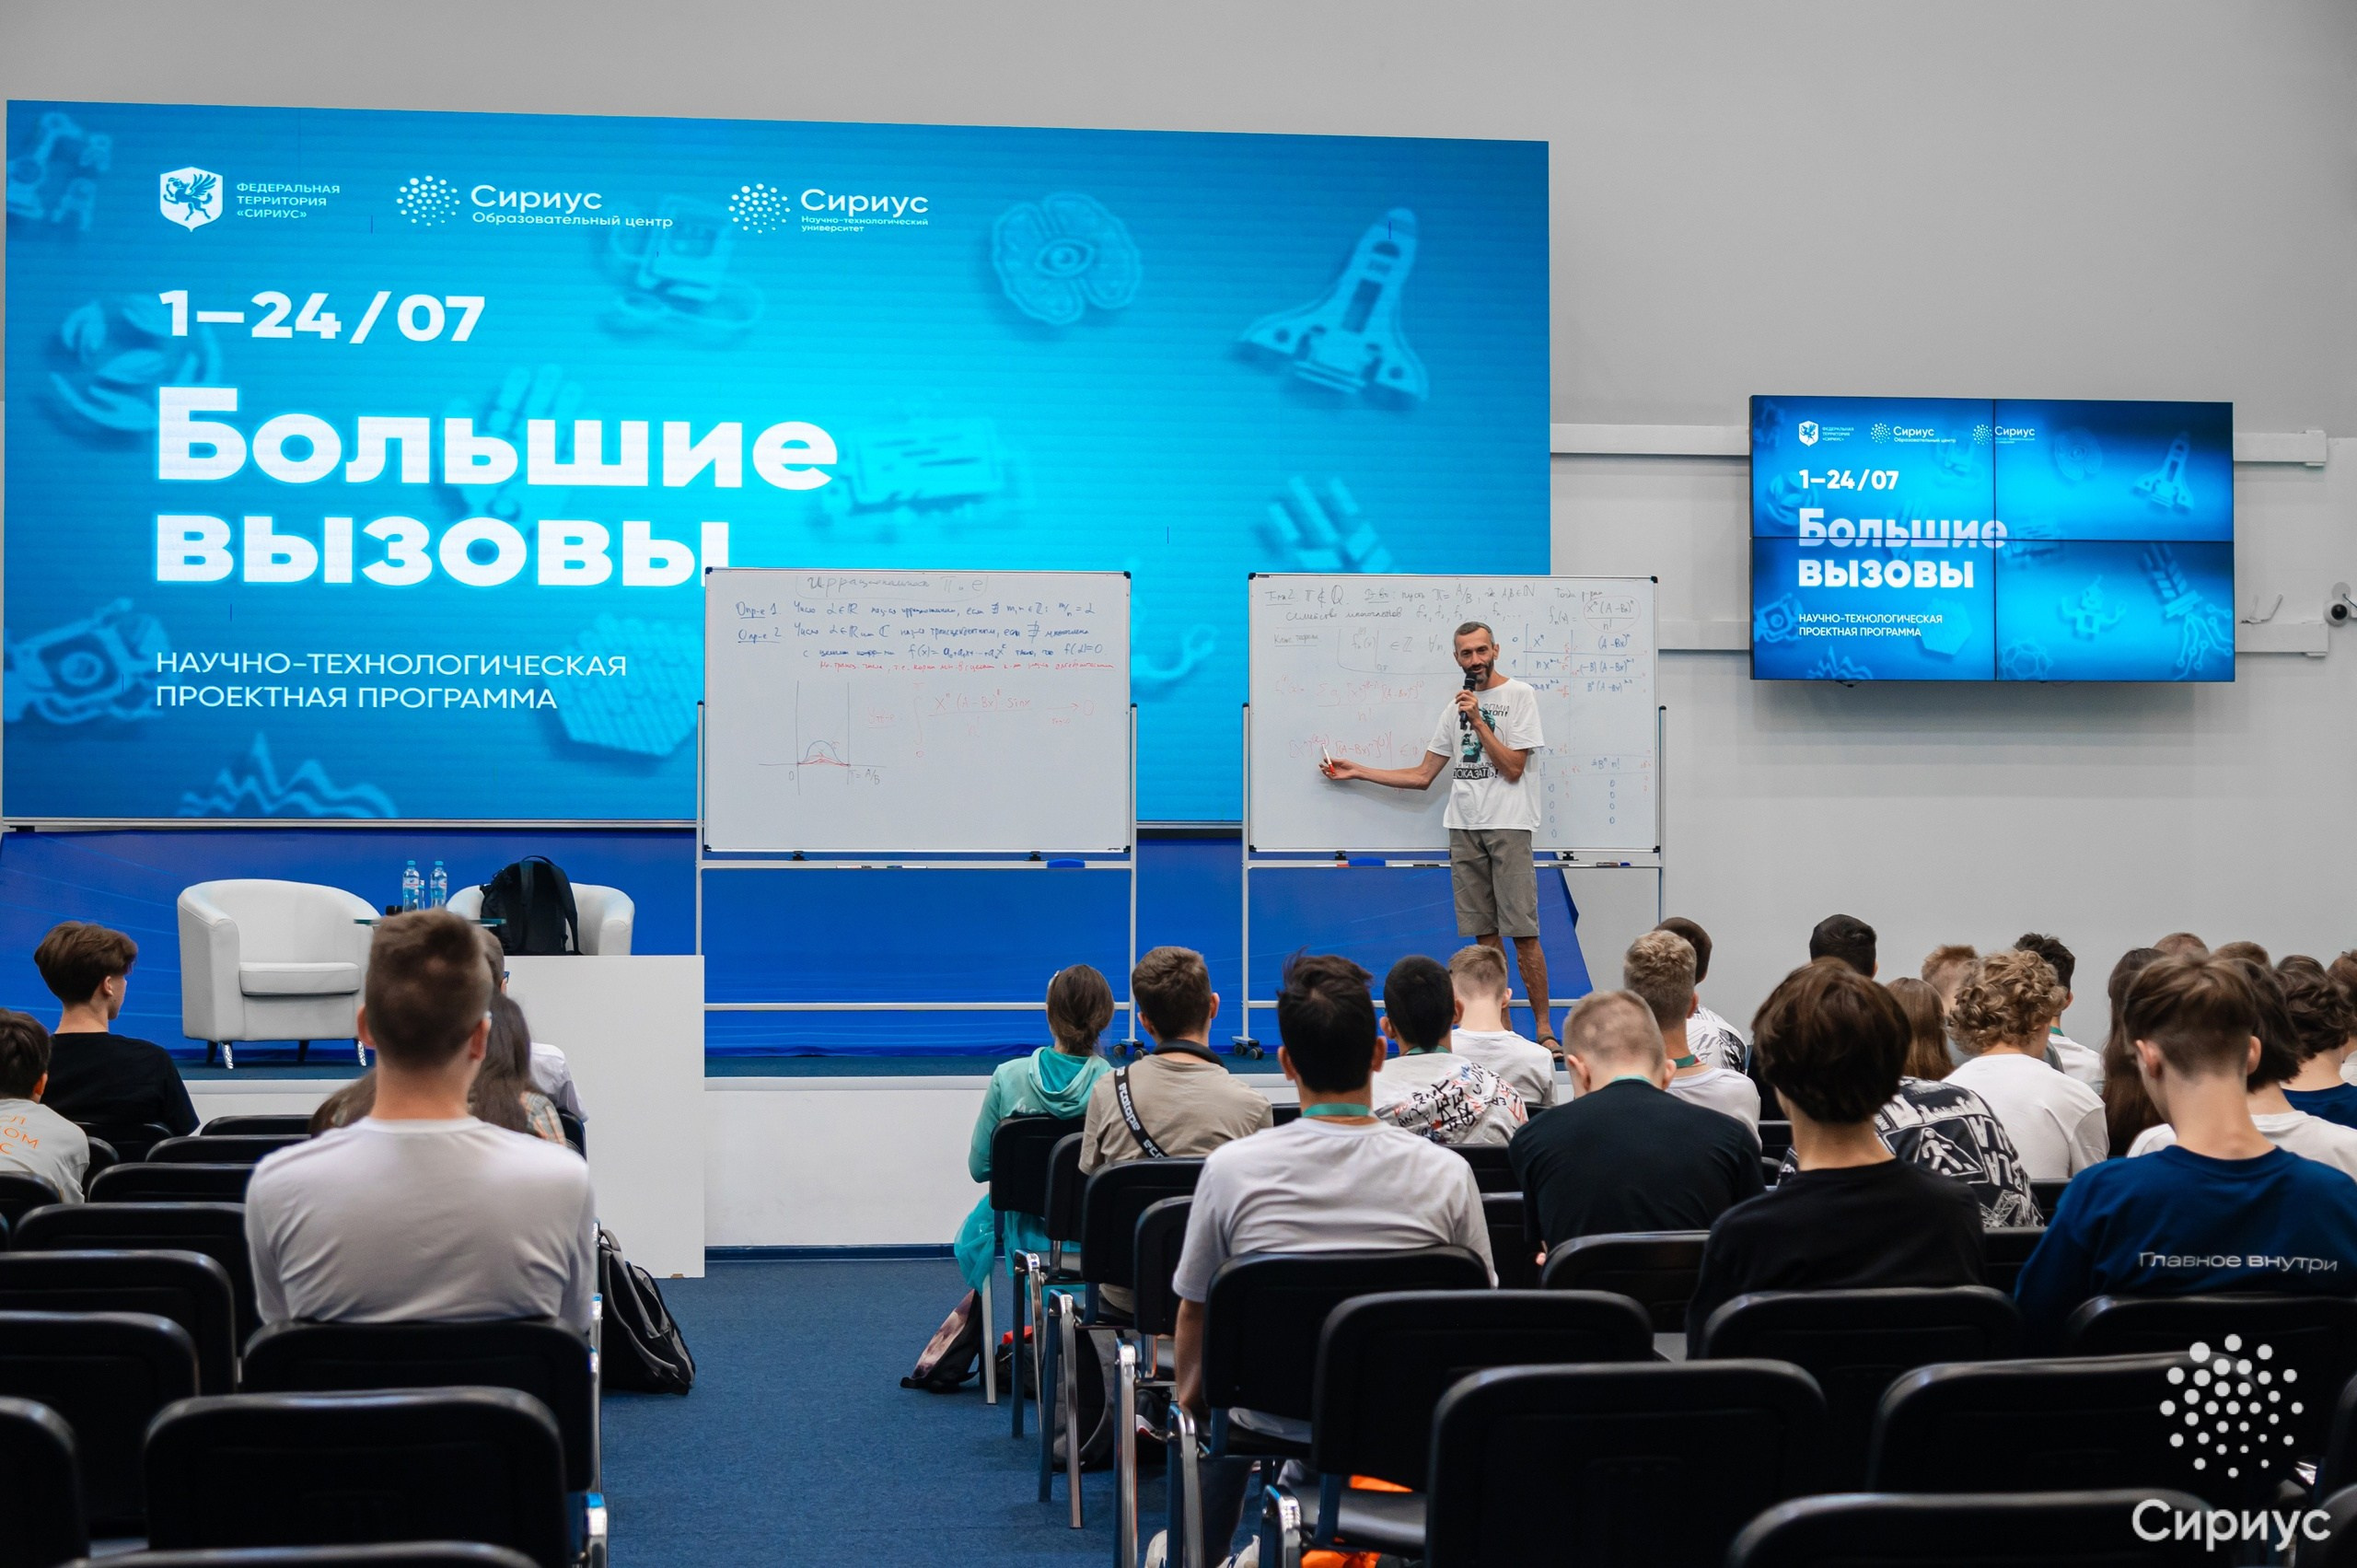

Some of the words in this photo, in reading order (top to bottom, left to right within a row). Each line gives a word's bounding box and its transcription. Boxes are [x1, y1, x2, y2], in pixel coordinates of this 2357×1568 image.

[237, 182, 341, 194] ФЕДЕРАЛЬНАЯ
[237, 195, 327, 206] ТЕРРИТОРИЯ
[470, 184, 603, 215] Сириус
[800, 188, 929, 218] Сириус
[237, 208, 308, 219] «СИРИУС»
[472, 212, 621, 226] Образовательный
[625, 216, 674, 229] центр
[801, 215, 929, 226] Научно-технологический
[801, 225, 865, 233] университет
[157, 386, 838, 491] Большие
[1893, 425, 1934, 438] Сириус
[1994, 425, 2036, 438] Сириус
[1798, 507, 2008, 549] Большие
[156, 514, 730, 587] вызовы
[1798, 559, 1974, 588] вызовы
[1798, 613, 1943, 624] НАУЧНО-ТЕХНОЛОГИЧЕСКАЯ
[1798, 626, 1858, 636] ПРОЕКТНАЯ
[1860, 626, 1922, 637] ПРОГРАММА
[157, 651, 627, 677] НАУЧНО-ТЕХНОЛОГИЧЕСКАЯ
[157, 685, 348, 708] ПРОЕКТНАЯ
[358, 687, 558, 709] ПРОГРАММА
[2138, 1251, 2243, 1269] Главное
[2247, 1253, 2340, 1274] внутри
